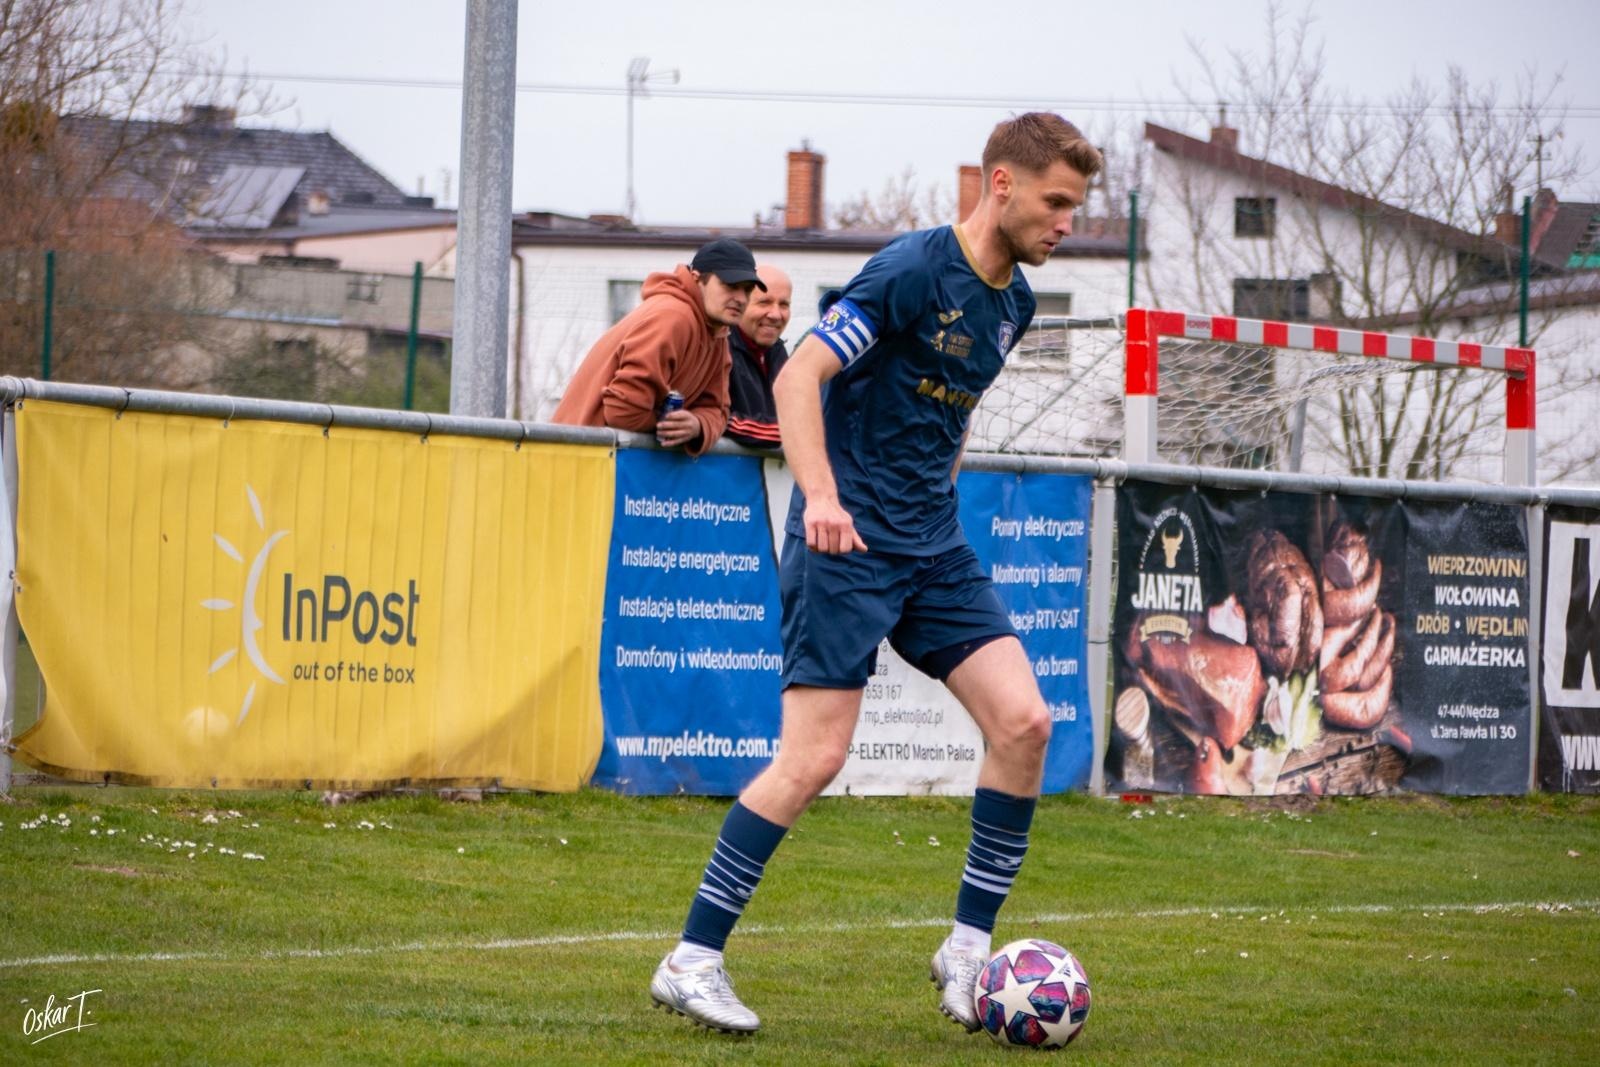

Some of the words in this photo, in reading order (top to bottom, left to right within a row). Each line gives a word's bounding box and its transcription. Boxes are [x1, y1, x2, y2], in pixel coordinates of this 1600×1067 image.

[624, 494, 679, 524] Instalacje
[681, 497, 751, 526] elektryczne
[1024, 515, 1085, 541] elektryczne
[622, 545, 677, 573] Instalacje
[679, 549, 760, 576] energetyczne
[991, 564, 1040, 588] Monitoring
[1042, 563, 1046, 583] i
[1047, 563, 1083, 587] alarmy
[1131, 573, 1203, 613] JANETA
[1435, 586, 1520, 607] WOŁOWINA
[283, 573, 420, 647] InPost
[619, 595, 675, 623] Instalacje
[677, 597, 765, 622] teletechniczne
[1036, 608, 1080, 630] RTV-SAT
[1416, 611, 1450, 634] DRÓB
[616, 645, 677, 673] Domofony
[679, 647, 686, 668] i
[687, 647, 783, 675] wideodomofony
[1036, 656, 1050, 676] do
[1051, 655, 1078, 675] bram
[1424, 641, 1526, 667] GARMAŻERKA
[294, 662, 319, 680] out
[324, 661, 344, 681] of
[349, 662, 378, 682] the
[384, 663, 415, 684] box
[886, 684, 902, 700] 167
[1467, 704, 1500, 722] Nędza
[1490, 725, 1498, 740] II
[1499, 725, 1517, 740] 30
[616, 730, 782, 763] www.mpelektro.com.p
[847, 743, 910, 761] P-ELEKTRO
[913, 744, 945, 761] Marcin
[947, 744, 975, 761] Palica
